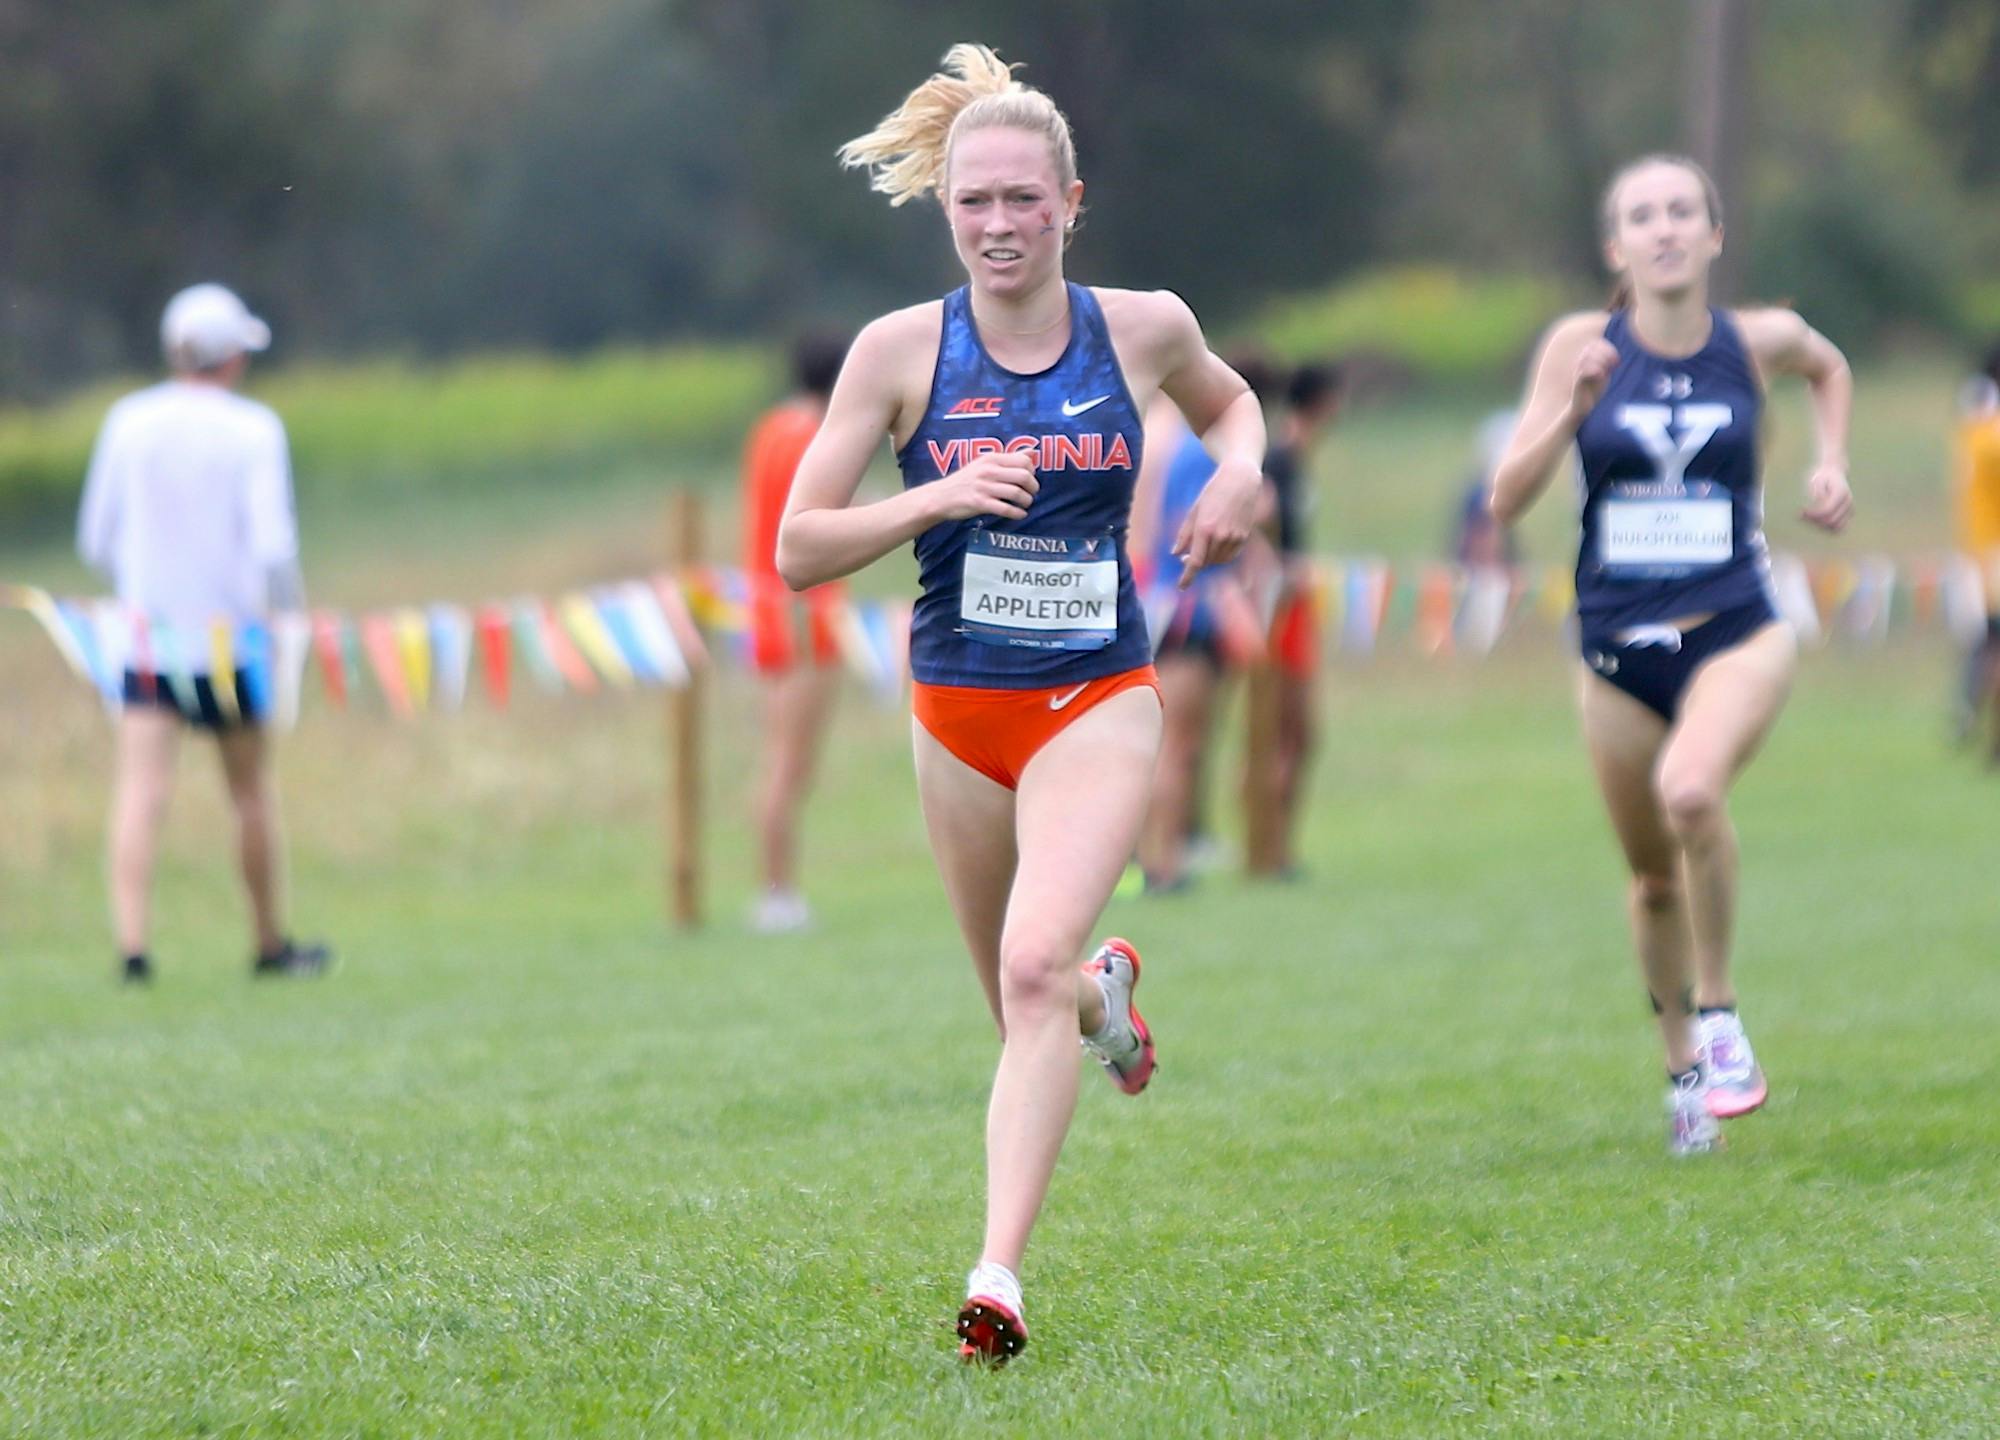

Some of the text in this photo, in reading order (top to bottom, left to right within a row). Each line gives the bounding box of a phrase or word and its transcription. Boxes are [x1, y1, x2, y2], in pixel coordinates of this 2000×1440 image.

[950, 397, 1005, 414] ACC
[1620, 406, 1732, 485] Y
[989, 532, 1068, 553] VIRGINIA
[1003, 569, 1083, 587] MARGOT
[976, 594, 1102, 619] APPLETON
